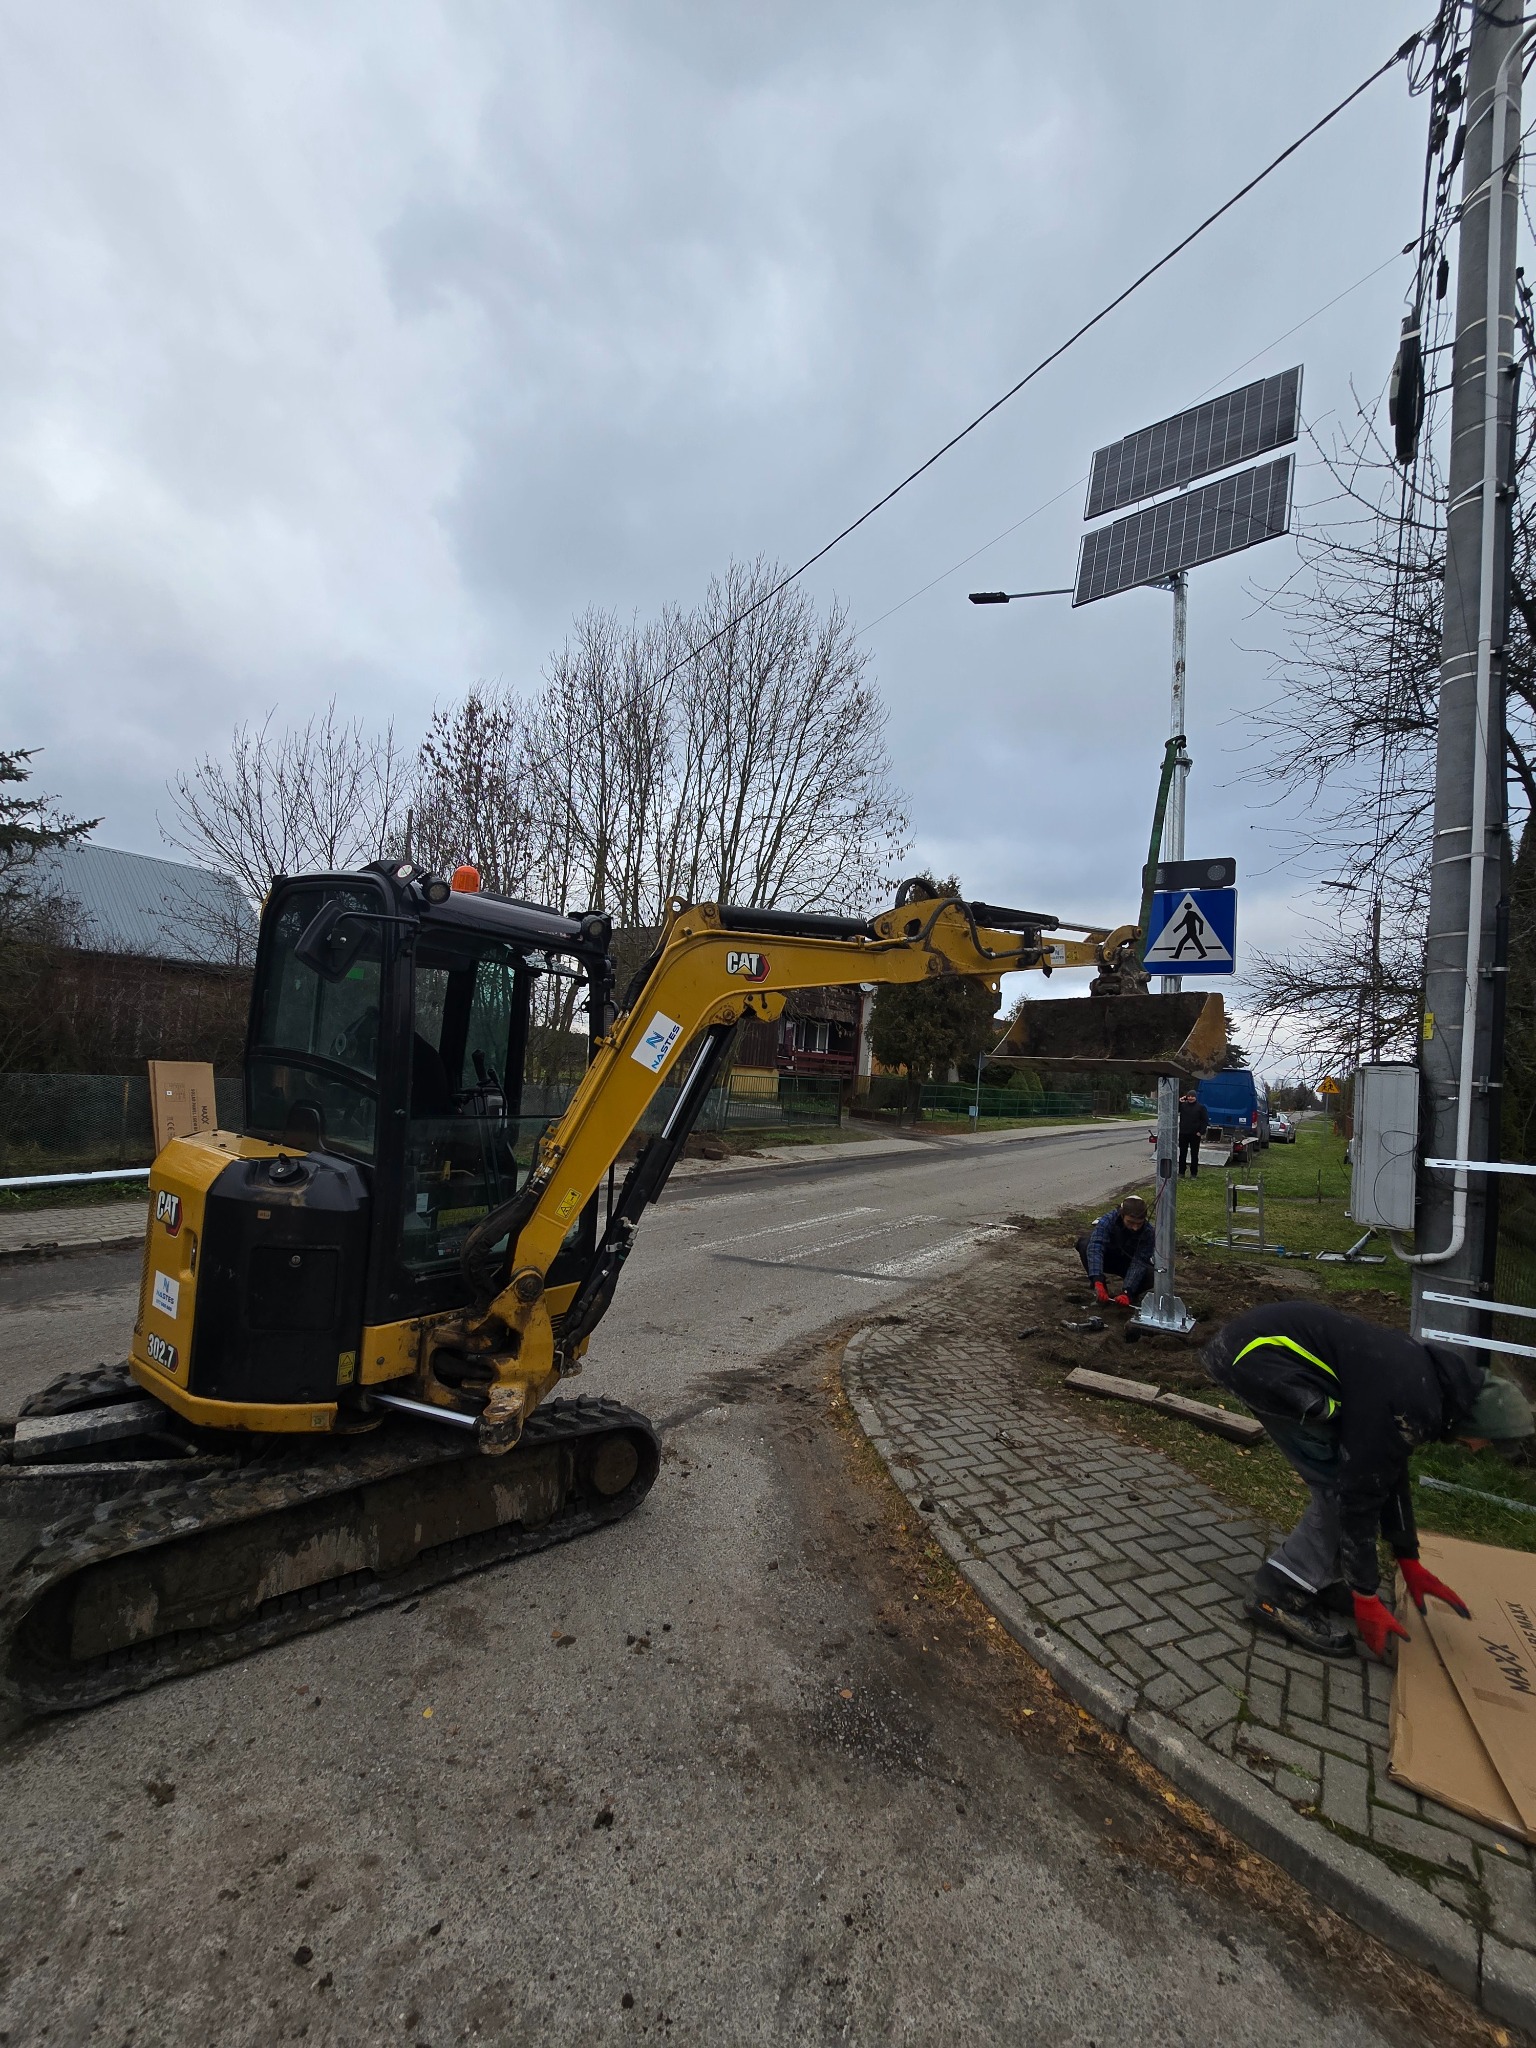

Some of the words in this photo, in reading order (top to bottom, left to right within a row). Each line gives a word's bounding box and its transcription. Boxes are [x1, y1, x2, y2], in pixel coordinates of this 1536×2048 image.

[727, 951, 760, 975] CAT
[651, 1024, 680, 1069] NASTES
[201, 1105, 210, 1125] MAXX
[156, 1190, 179, 1226] CAT
[156, 1289, 175, 1305] NASTES
[147, 1333, 175, 1368] 302.7
[1505, 1600, 1536, 1631] MAXX
[1478, 1635, 1536, 1696] MAXX
